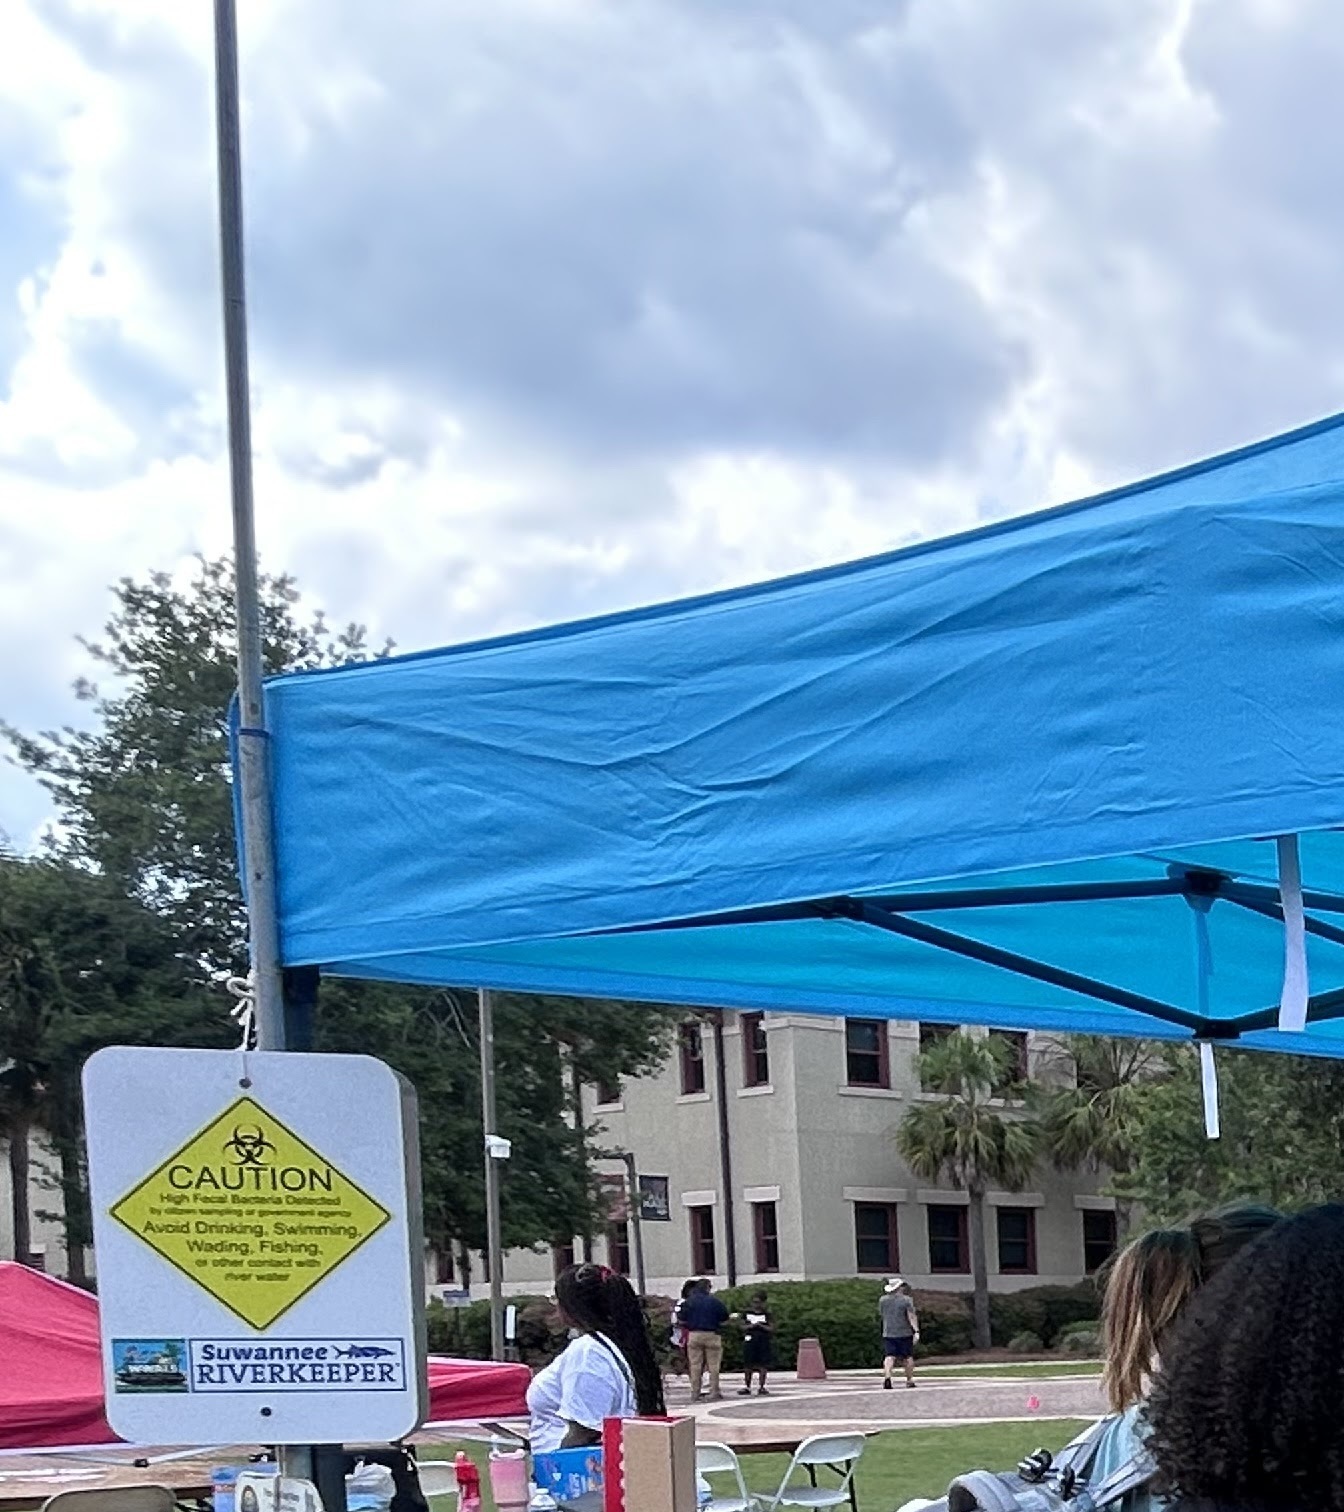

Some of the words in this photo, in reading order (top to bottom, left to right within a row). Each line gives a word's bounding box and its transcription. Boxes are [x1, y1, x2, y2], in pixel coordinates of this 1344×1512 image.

[168, 1165, 332, 1191] CAUTION
[160, 1193, 189, 1205] High
[193, 1194, 227, 1204] Fecal
[231, 1195, 282, 1205] Bacteria
[286, 1195, 341, 1206] Detected
[143, 1221, 189, 1234] Avoid
[195, 1222, 269, 1237] Drinking,
[273, 1222, 363, 1239] Swimming,
[186, 1240, 254, 1255] Wading,
[259, 1241, 323, 1256] Fishing,
[201, 1344, 328, 1360] Suwannee
